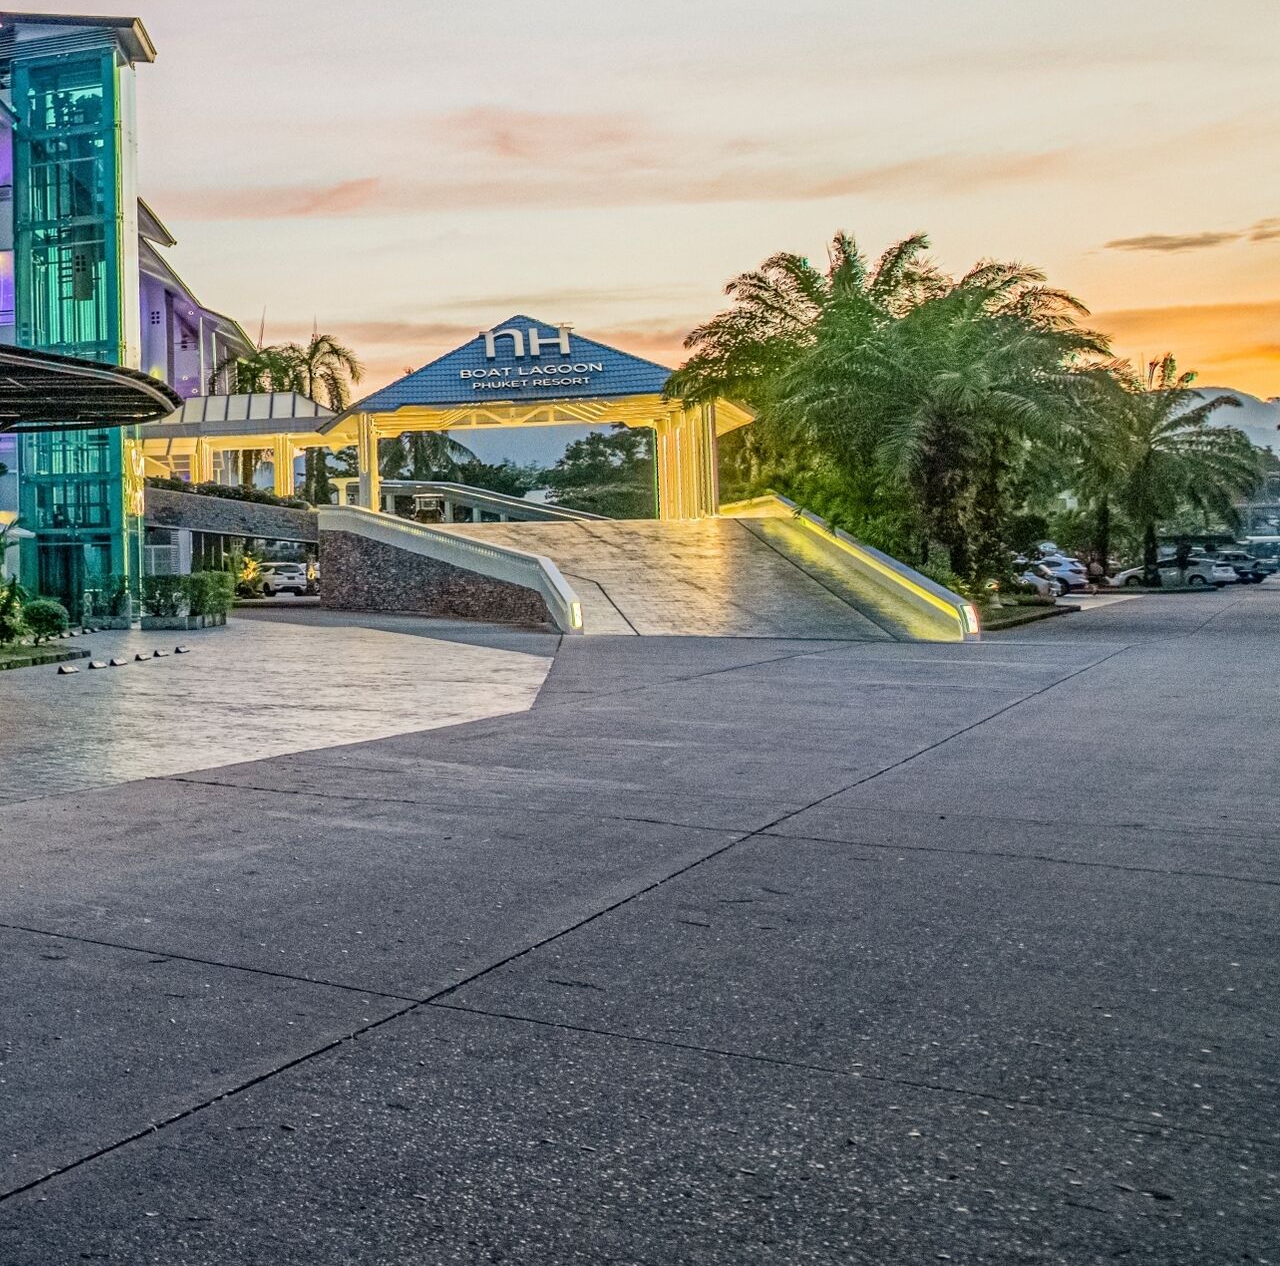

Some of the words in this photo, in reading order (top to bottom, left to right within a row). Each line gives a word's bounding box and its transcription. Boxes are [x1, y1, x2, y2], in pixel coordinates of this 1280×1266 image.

[479, 328, 572, 358] nH
[460, 367, 512, 380] BOAT
[519, 363, 603, 377] LAGOON
[472, 380, 527, 390] PHUKET
[533, 377, 590, 387] RESORT
